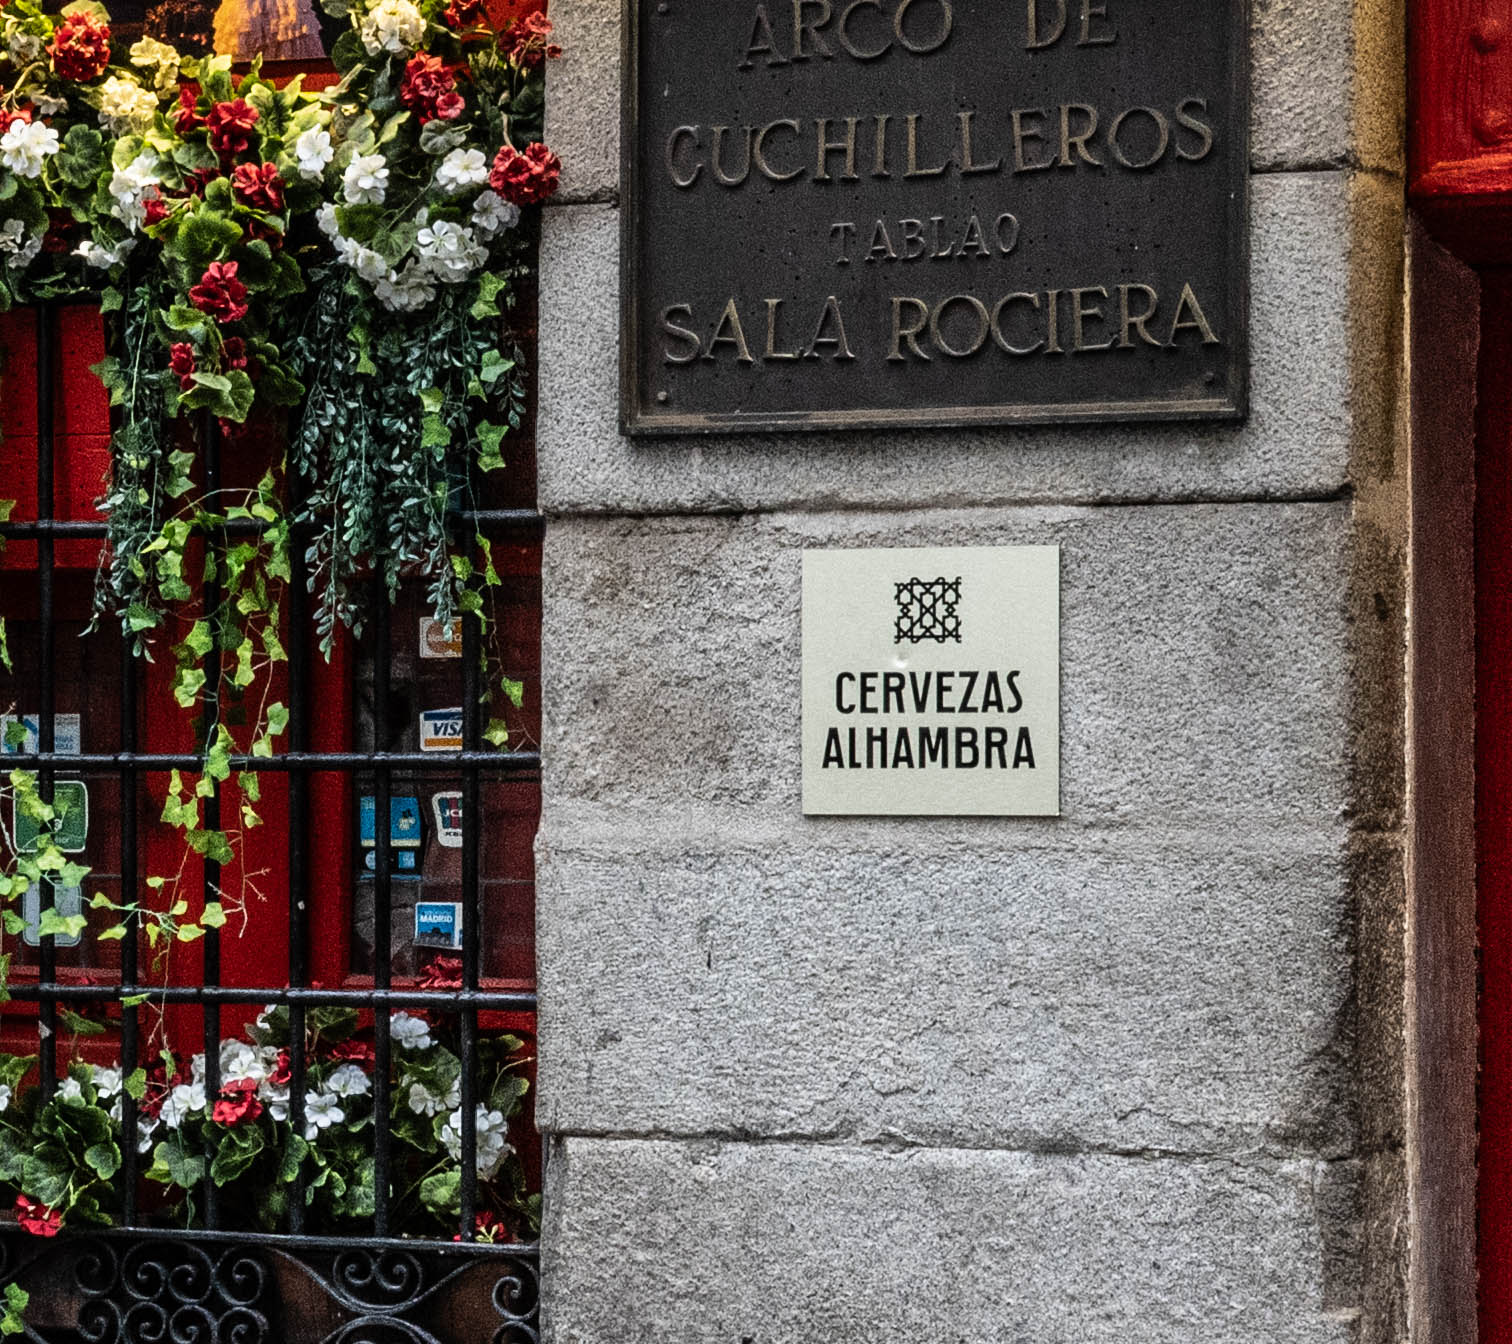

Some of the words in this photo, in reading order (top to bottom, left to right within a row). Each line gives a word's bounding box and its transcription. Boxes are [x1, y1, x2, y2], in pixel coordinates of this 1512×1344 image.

[665, 97, 1216, 189] CUCHILLEROS
[828, 212, 1021, 266] TABLAO
[659, 296, 856, 364] SALA
[885, 282, 1220, 361] ROCIERA
[835, 670, 1023, 714] CERVEZAS
[821, 726, 1036, 769] ALHAMBRA
